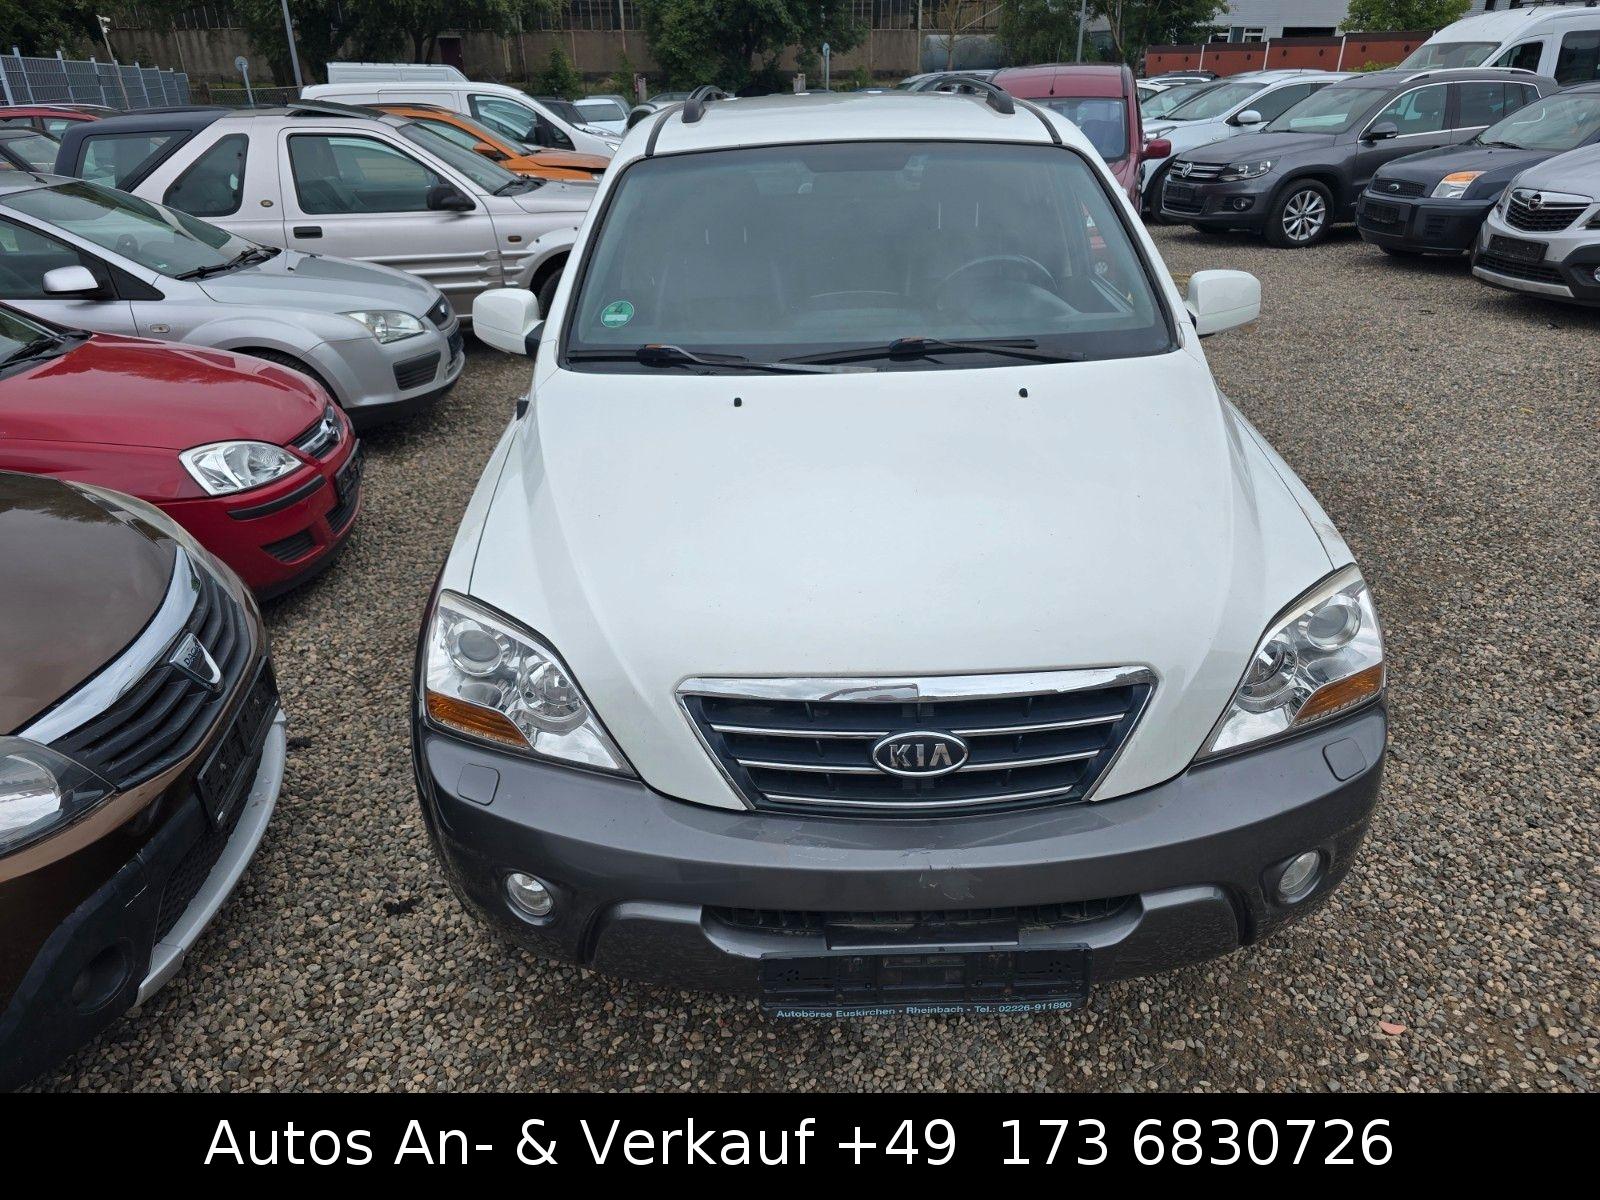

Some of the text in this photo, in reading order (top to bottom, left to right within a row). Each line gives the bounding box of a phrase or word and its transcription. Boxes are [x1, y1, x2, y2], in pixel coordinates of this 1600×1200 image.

[614, 302, 623, 314] 4
[889, 743, 952, 767] KIA
[776, 1010, 833, 1018] Autobörse
[836, 1008, 896, 1017] Euskirchen
[906, 1006, 964, 1014] Rheinbach
[974, 1005, 996, 1013] Tel.:
[998, 1001, 1072, 1013] 02226-911890
